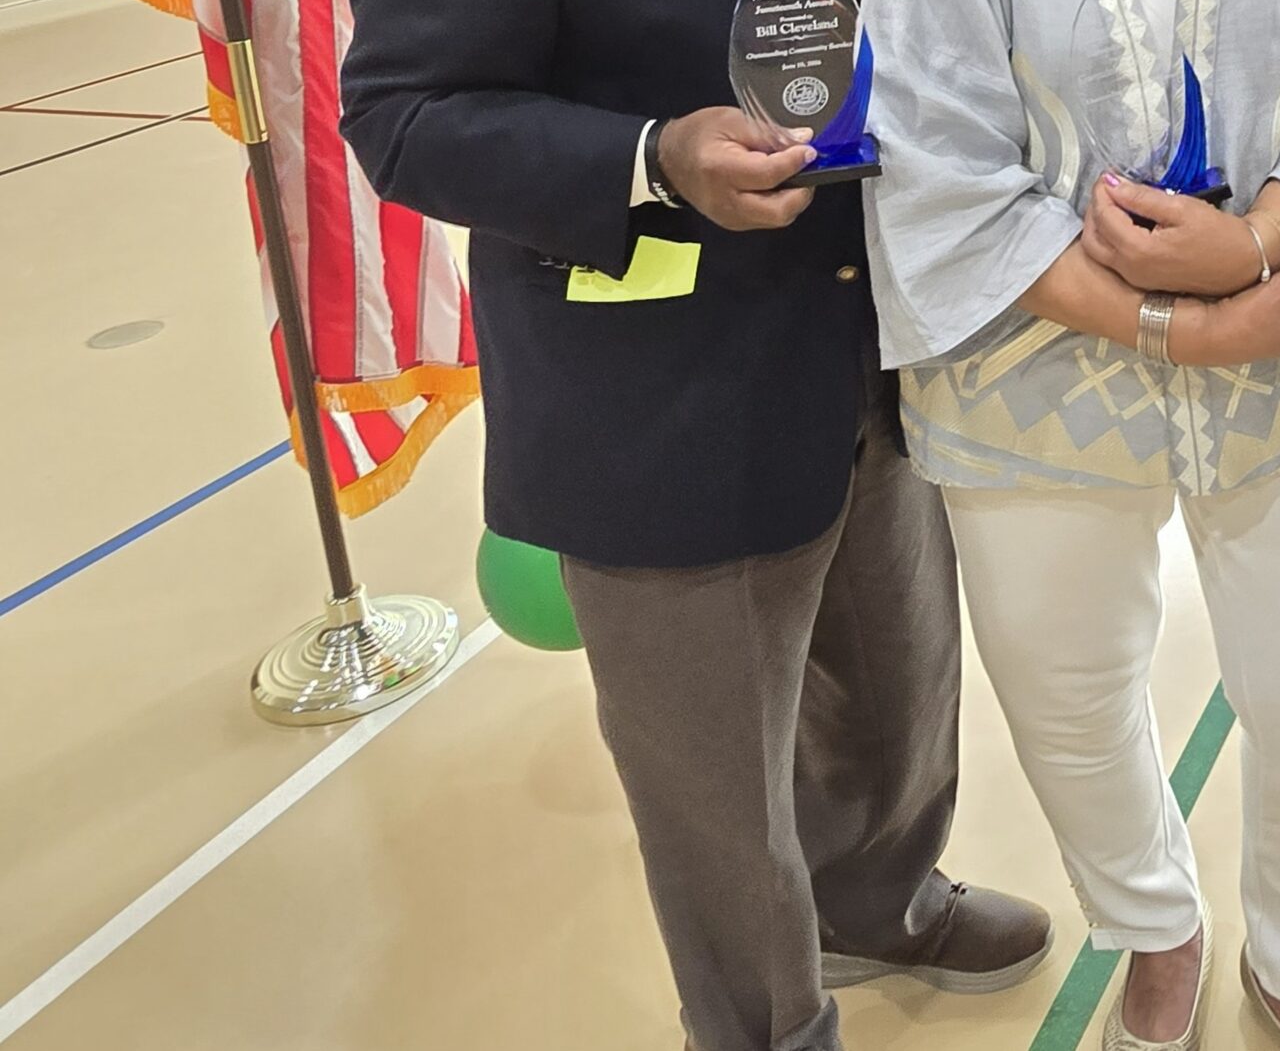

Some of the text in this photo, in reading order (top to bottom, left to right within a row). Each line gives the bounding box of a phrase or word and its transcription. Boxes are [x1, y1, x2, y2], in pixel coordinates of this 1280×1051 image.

[755, 0, 802, 14] Juneteenth
[756, 16, 839, 38] Bill Cleveland
